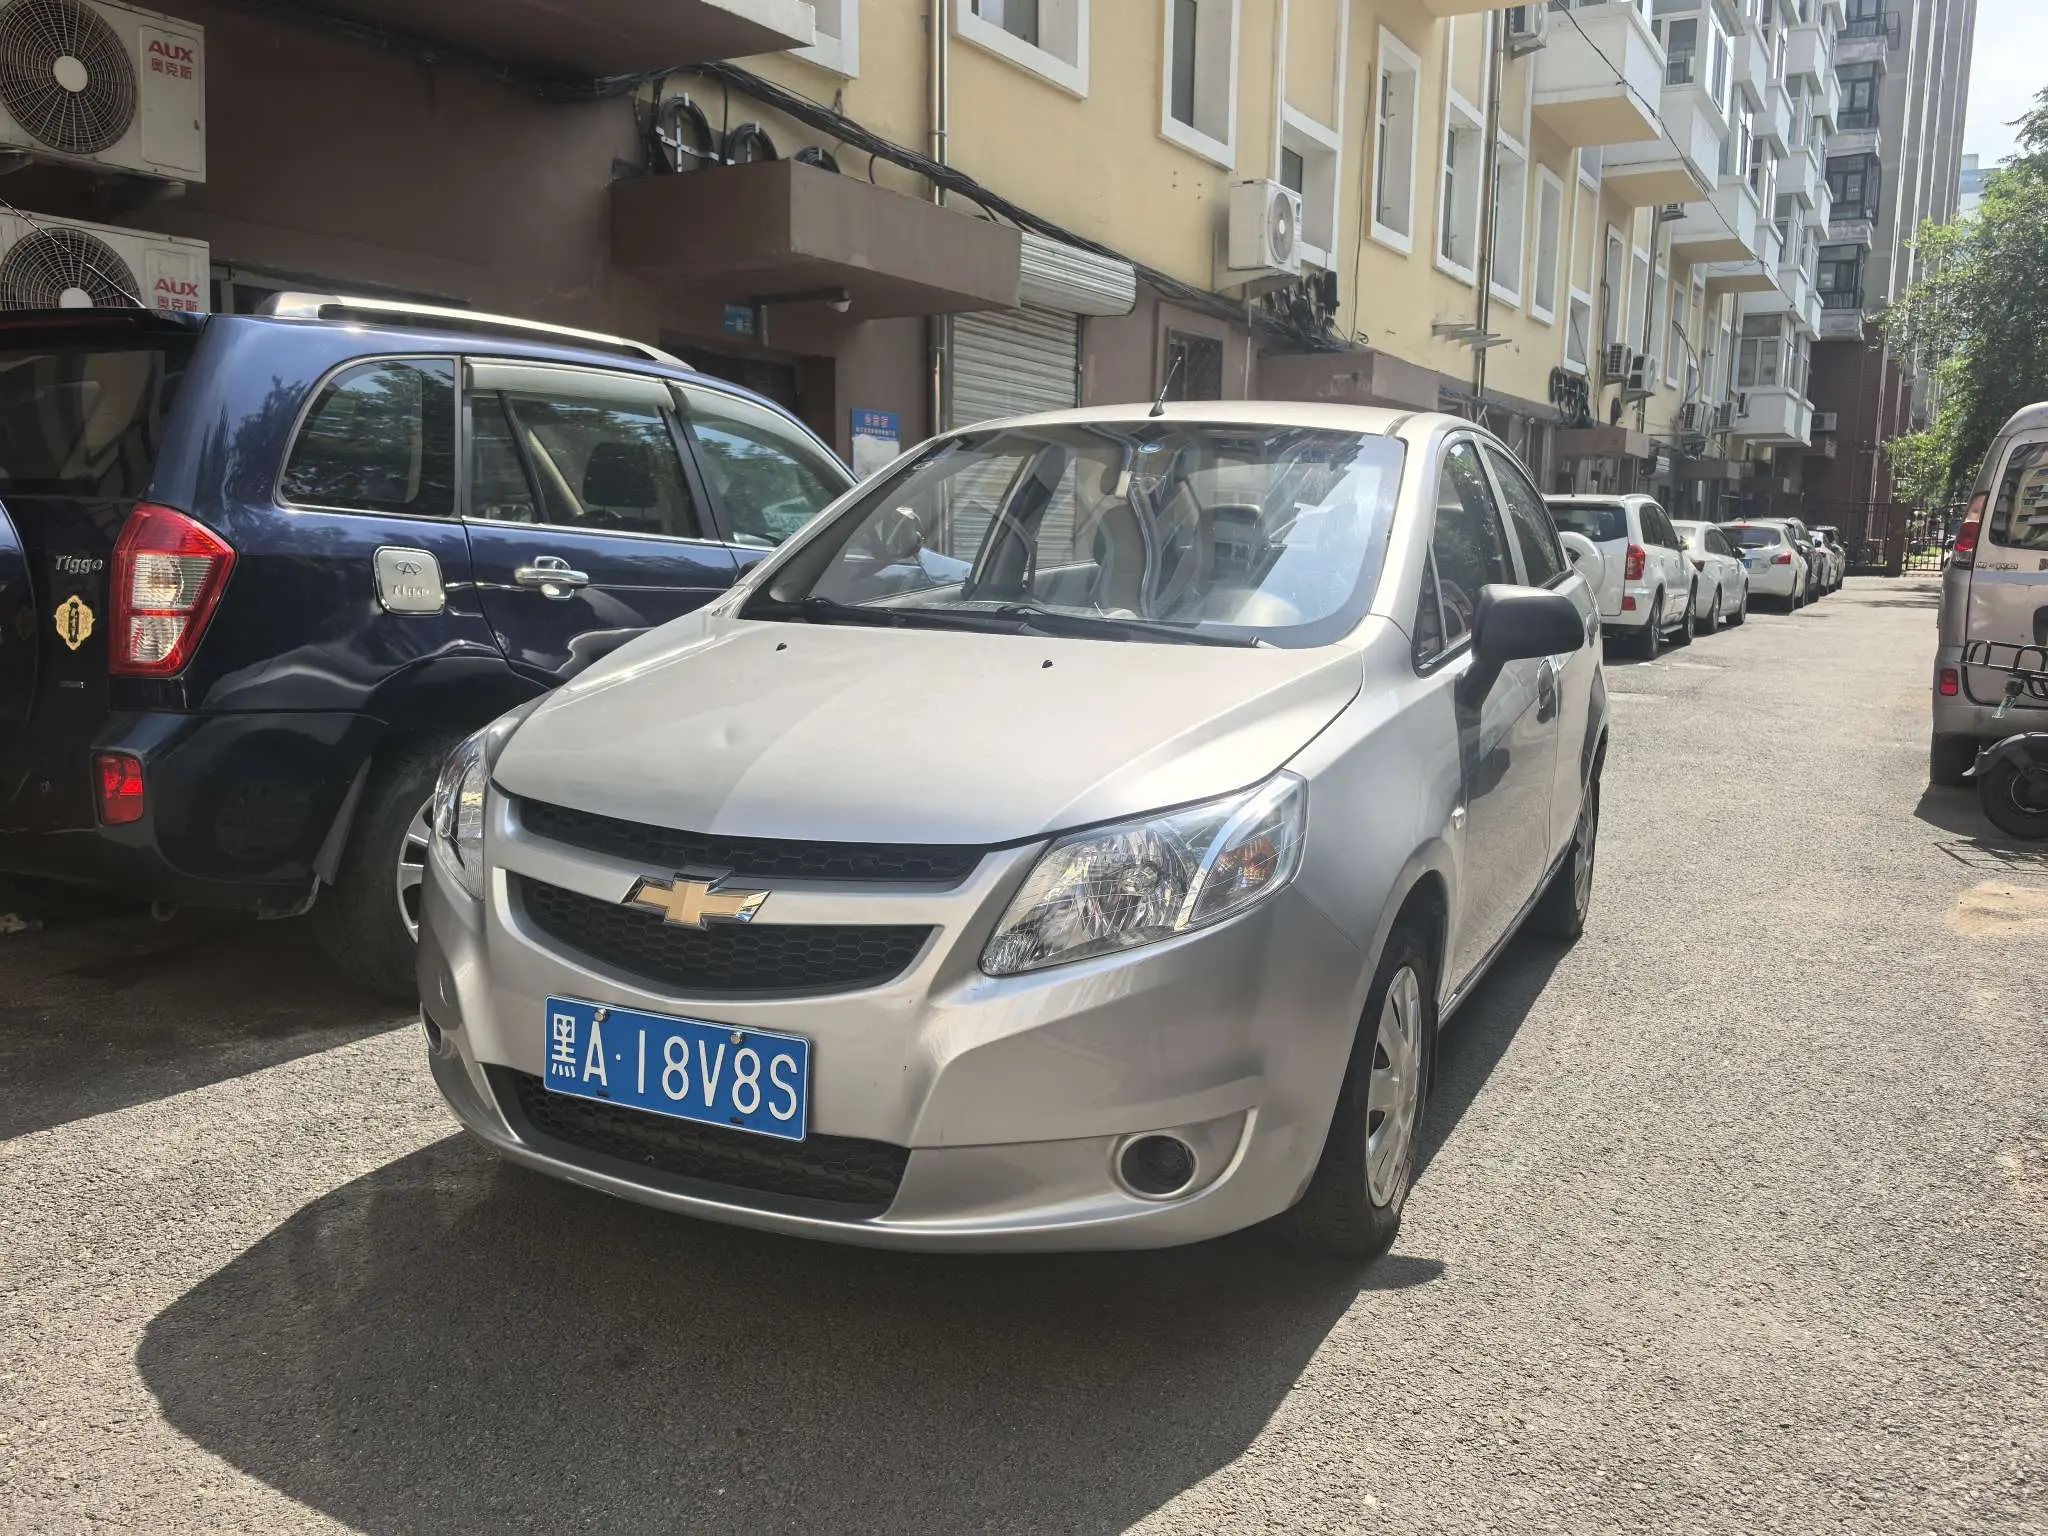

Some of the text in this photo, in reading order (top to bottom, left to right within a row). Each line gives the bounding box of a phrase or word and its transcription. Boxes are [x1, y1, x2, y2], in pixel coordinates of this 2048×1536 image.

[149, 39, 194, 63] AUX
[151, 57, 192, 81] 奥克斯
[154, 278, 199, 297] AUX
[55, 554, 103, 574] Tiggo
